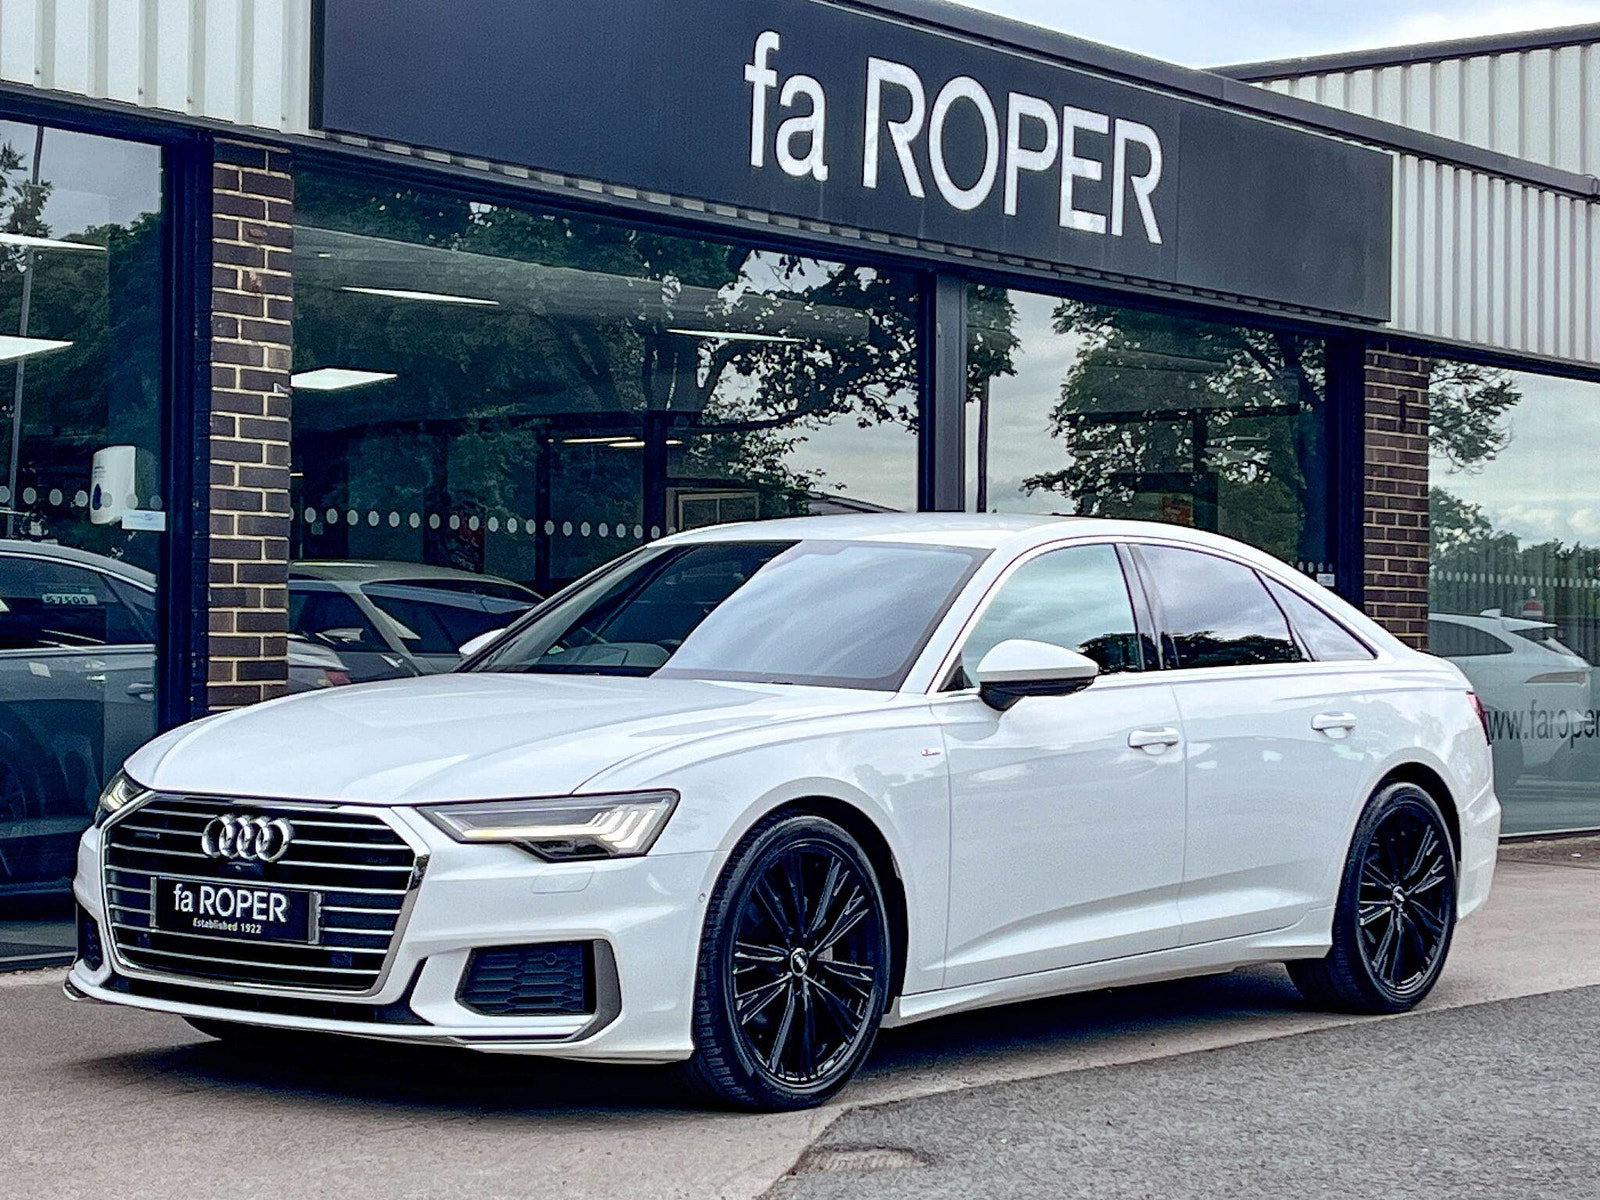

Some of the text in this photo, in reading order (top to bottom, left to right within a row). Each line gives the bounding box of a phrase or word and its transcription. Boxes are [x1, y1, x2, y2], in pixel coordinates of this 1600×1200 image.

[744, 30, 1163, 245] fa ROPER
[173, 883, 288, 923] fa ROPER
[192, 918, 262, 934] Established 1922
